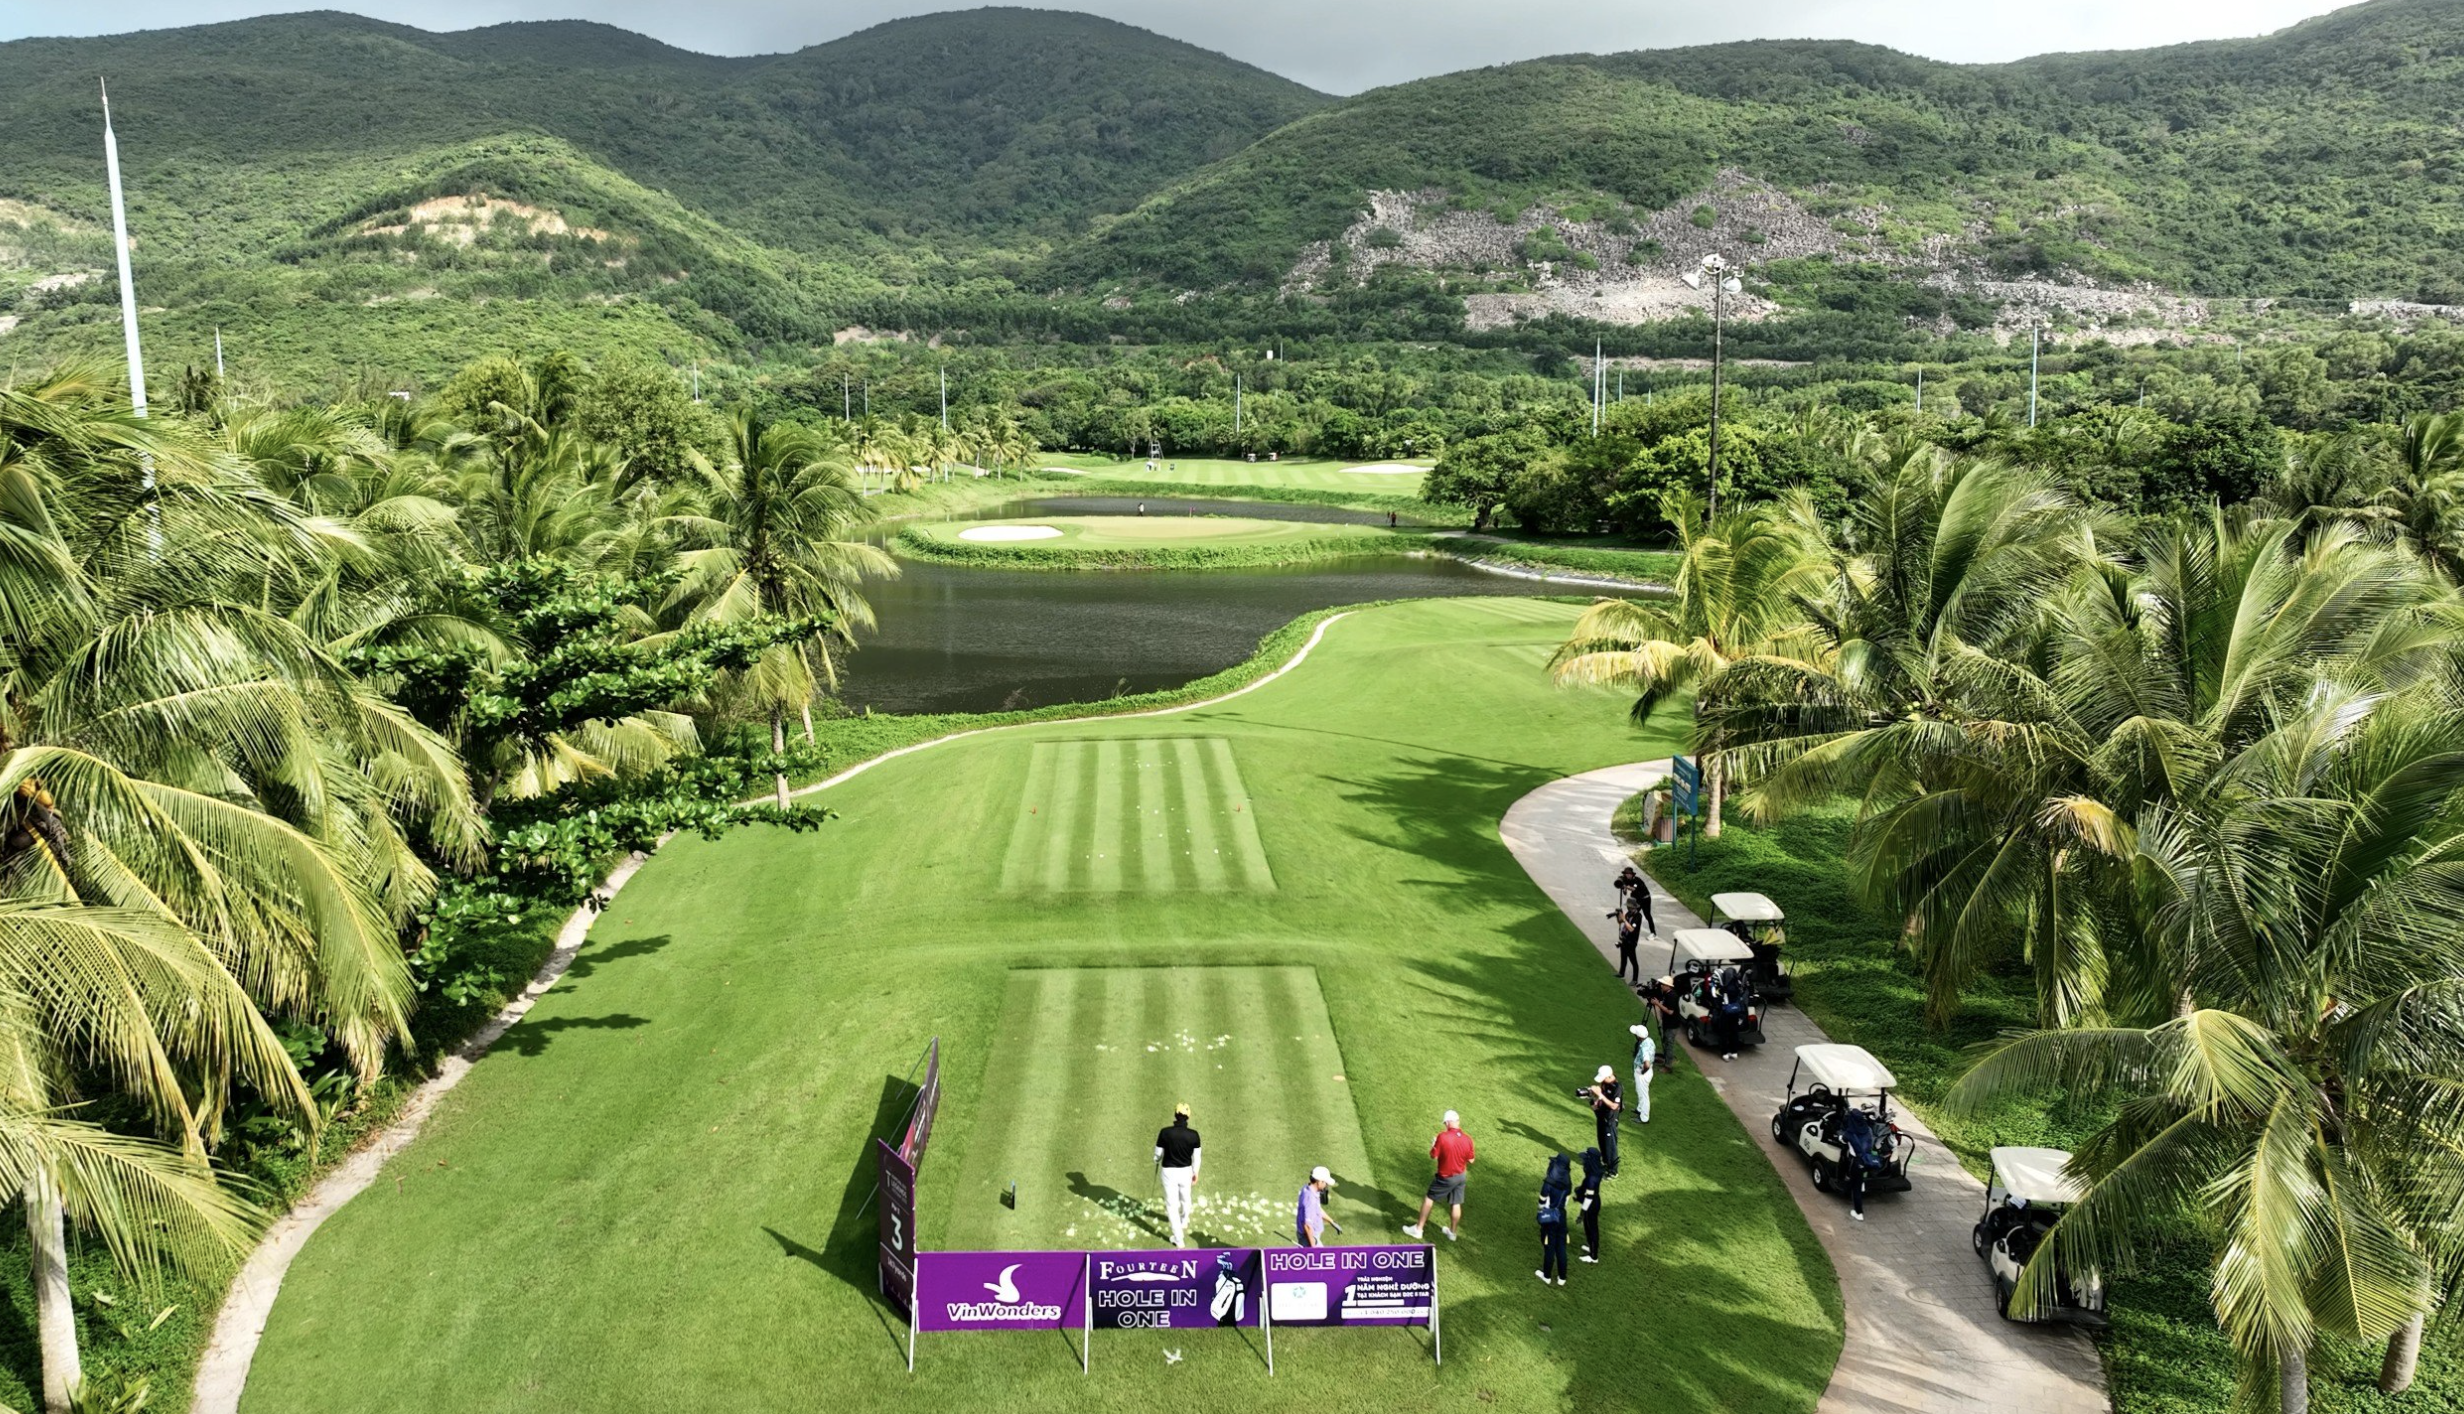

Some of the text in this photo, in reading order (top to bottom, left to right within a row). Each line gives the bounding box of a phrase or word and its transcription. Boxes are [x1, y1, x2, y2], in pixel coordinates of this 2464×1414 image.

[891, 1213, 903, 1251] 3
[1270, 1251, 1425, 1271] HOLE IN ONE
[1341, 1284, 1357, 1307] 1
[1356, 1283, 1375, 1291] NĂM
[1098, 1289, 1197, 1308] HOLE IN
[947, 1302, 1061, 1321] VinWonders
[1117, 1310, 1171, 1328] ONE
